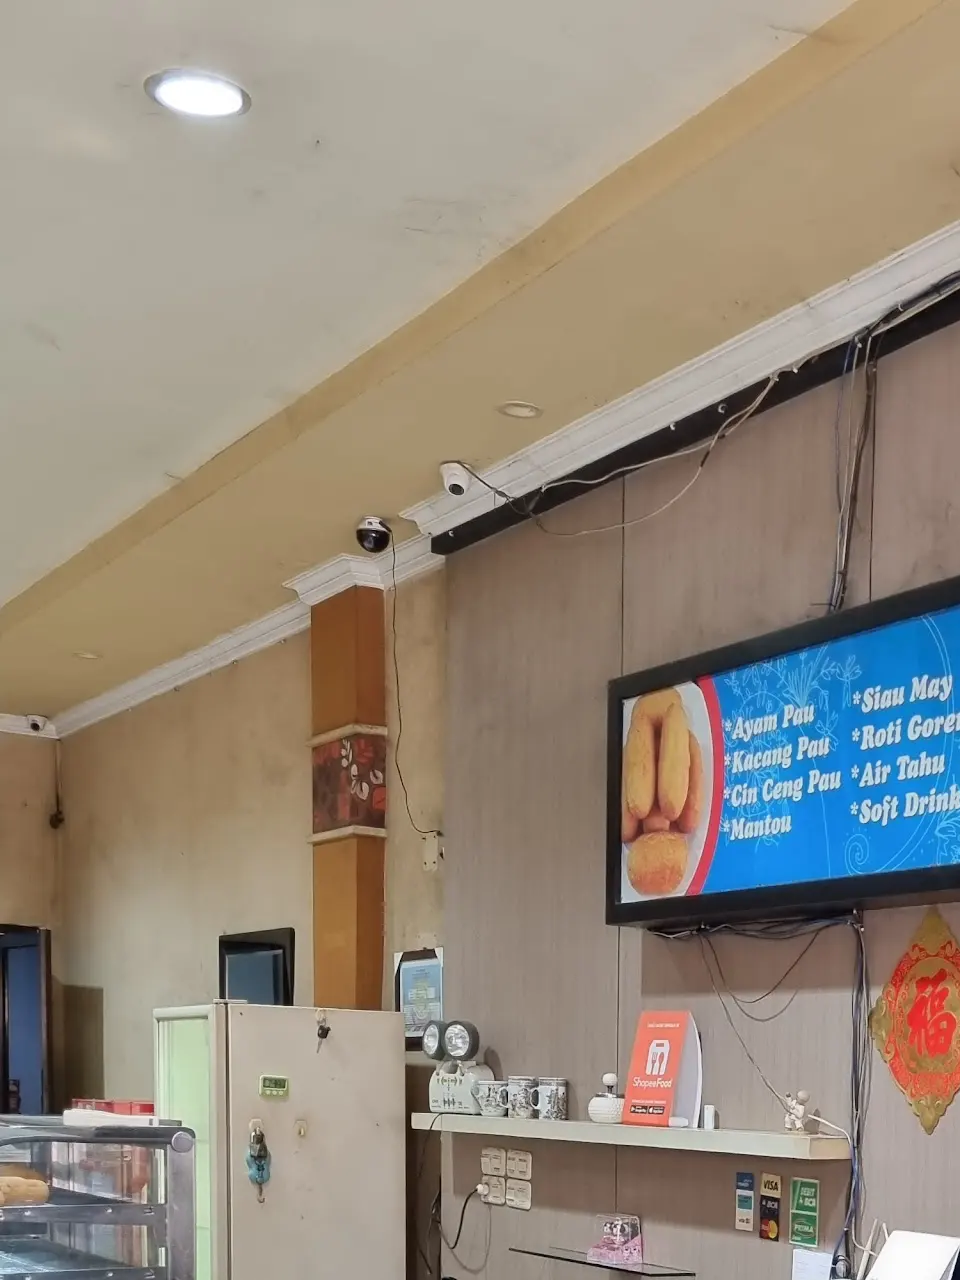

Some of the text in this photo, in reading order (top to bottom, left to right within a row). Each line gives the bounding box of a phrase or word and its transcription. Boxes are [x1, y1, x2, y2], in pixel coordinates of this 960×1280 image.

[861, 673, 953, 713] Siau May
[731, 703, 815, 742] Ayam Pau
[860, 718, 901, 750] Roti
[731, 735, 830, 774] Kacang Pau
[859, 751, 946, 788] Air Tahu
[731, 767, 841, 807] Cin Ceng Pau
[730, 813, 792, 841] Mantou
[859, 795, 899, 827] Soft
[906, 967, 957, 1057] 福
[632, 1077, 673, 1090] ShopeeFood
[763, 1180, 779, 1192] VISA
